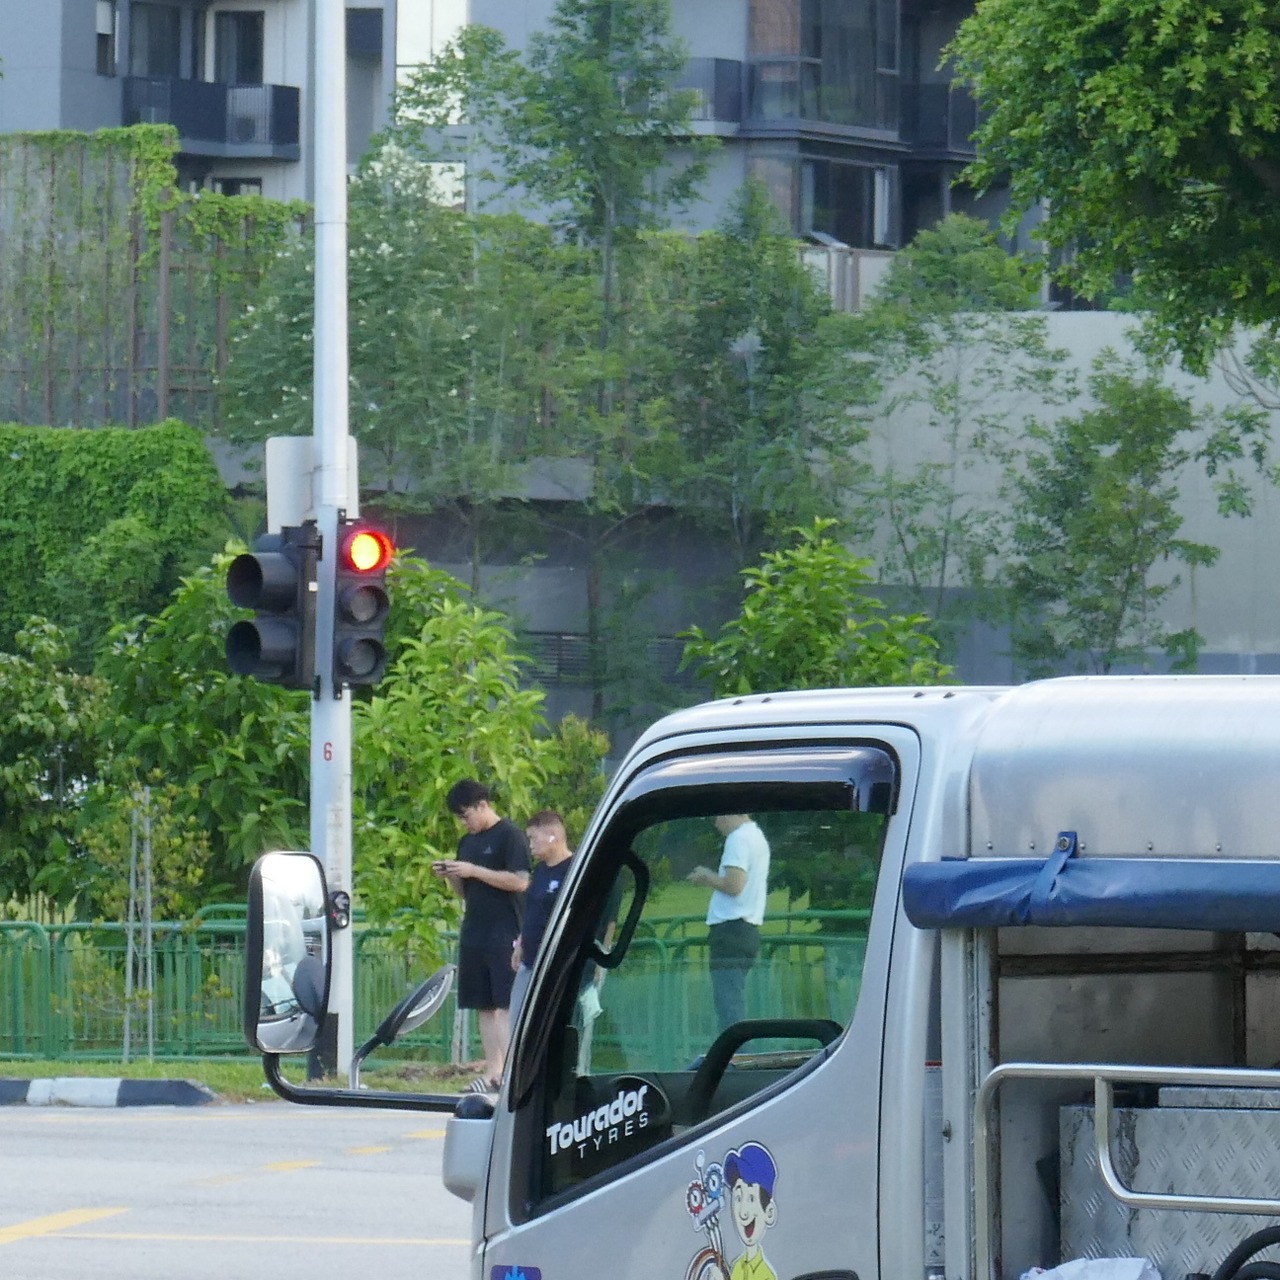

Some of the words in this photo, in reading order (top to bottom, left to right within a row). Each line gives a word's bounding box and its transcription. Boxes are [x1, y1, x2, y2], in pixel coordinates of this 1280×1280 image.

[323, 741, 333, 762] 6
[546, 1085, 648, 1155] Tourador
[578, 1112, 648, 1159] TYRES
